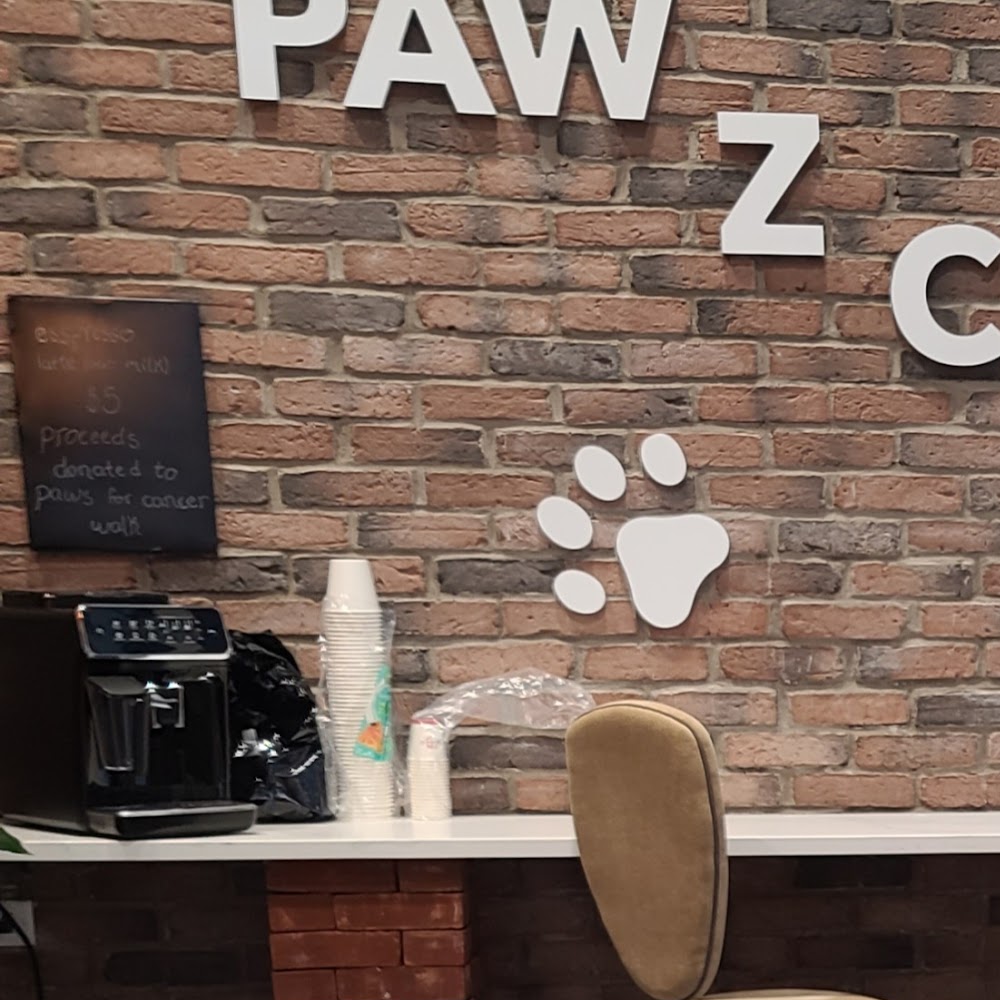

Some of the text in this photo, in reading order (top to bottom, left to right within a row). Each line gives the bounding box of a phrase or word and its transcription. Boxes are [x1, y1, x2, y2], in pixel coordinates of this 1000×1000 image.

[233, 0, 672, 120] PAW
[717, 112, 825, 256] Z
[52, 456, 179, 481] donated to
[107, 486, 133, 505] for
[141, 494, 210, 510] cancer
